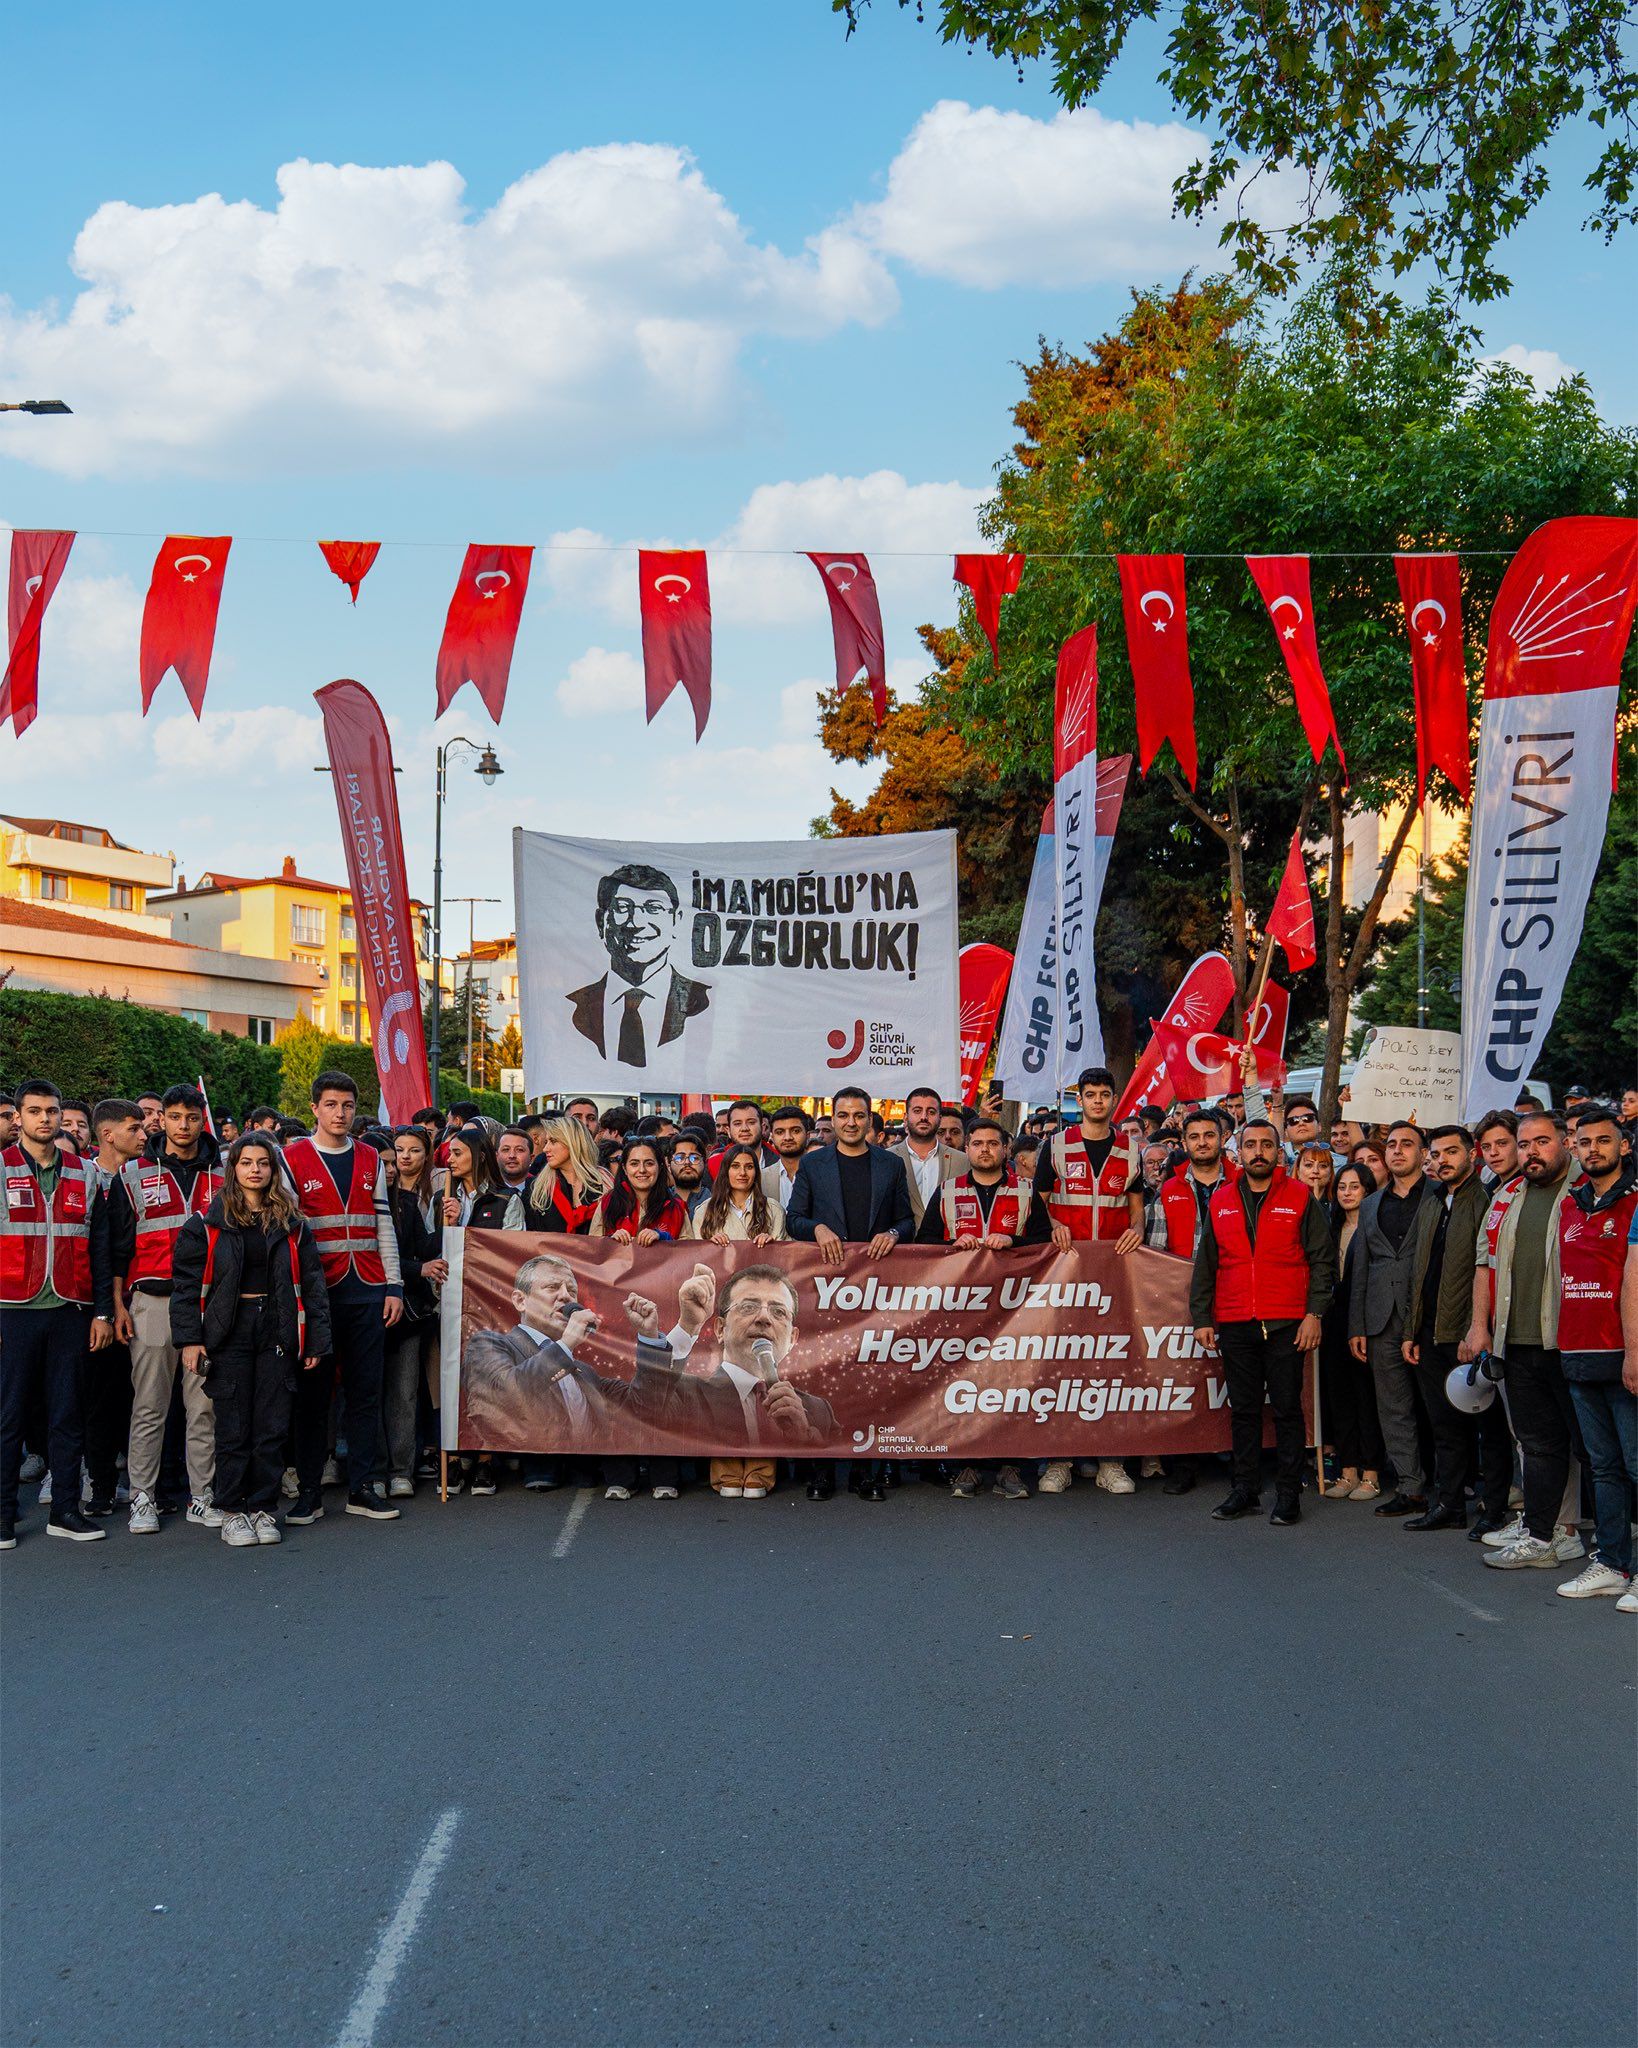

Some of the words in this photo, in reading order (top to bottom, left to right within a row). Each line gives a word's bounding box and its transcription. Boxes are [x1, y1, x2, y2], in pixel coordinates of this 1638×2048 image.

[1490, 730, 1575, 952] SİLİVRİ
[870, 1022, 894, 1032] CHP
[1486, 969, 1543, 1083] CHP
[869, 1032, 905, 1044] SİLİVRİ
[1022, 996, 1054, 1074] CHP
[869, 1043, 916, 1057] GENÇLİK
[1428, 1044, 1453, 1056] BEY
[869, 1056, 913, 1067] KOLLARI
[813, 1276, 992, 1311] Yolumuz
[999, 1277, 1112, 1315] Uzun,
[857, 1329, 1131, 1371] Heyecanımız
[944, 1378, 1193, 1423] Gençliğimiz
[878, 1434, 915, 1443] İSTANBUL
[878, 1445, 913, 1454] GENÇLİK
[914, 1445, 948, 1453] KOLLARI
